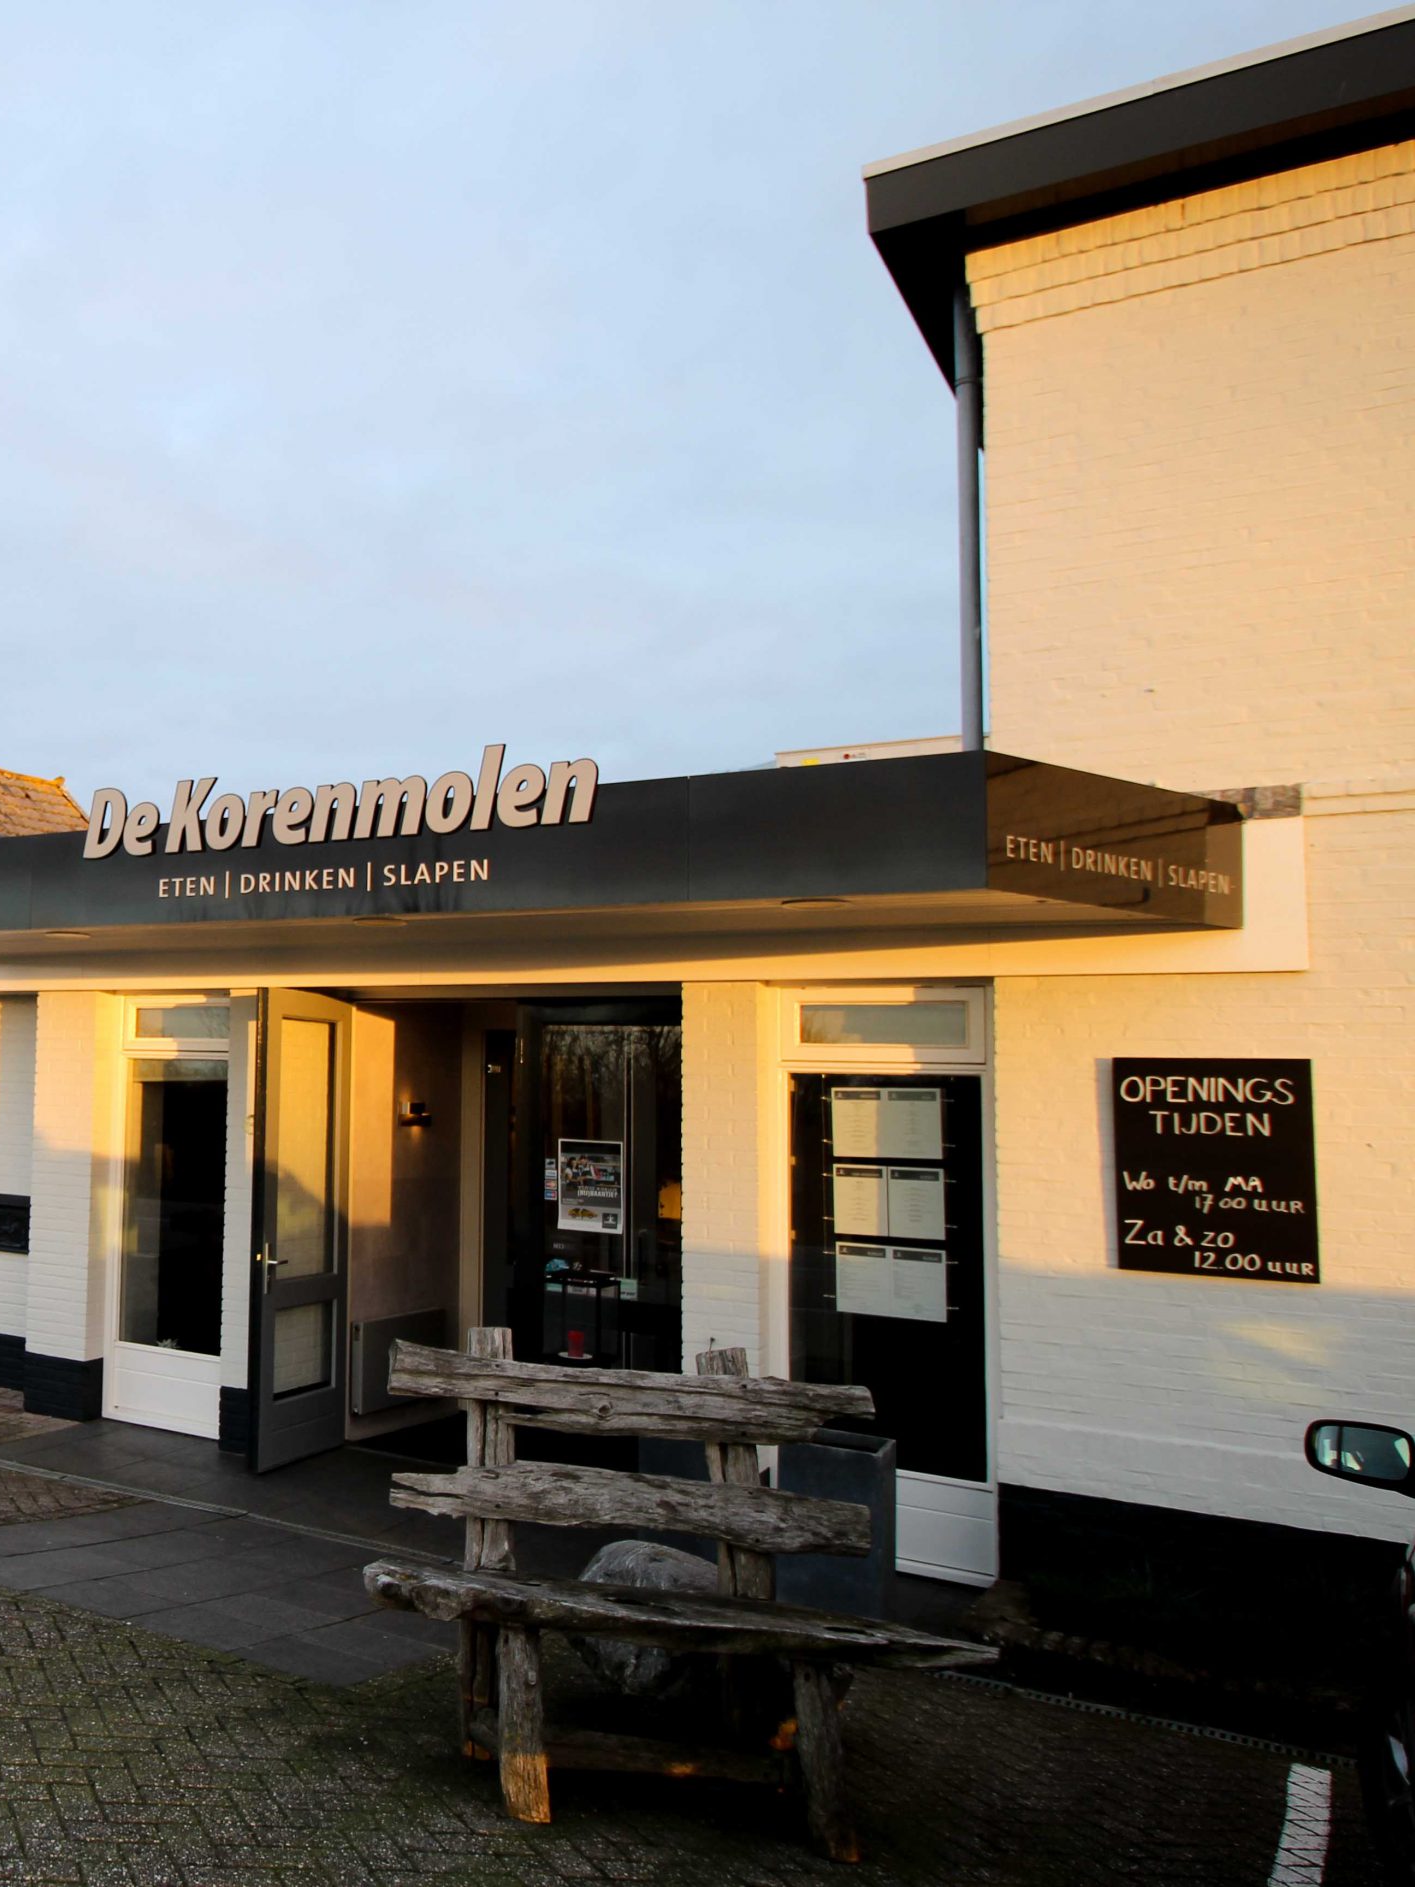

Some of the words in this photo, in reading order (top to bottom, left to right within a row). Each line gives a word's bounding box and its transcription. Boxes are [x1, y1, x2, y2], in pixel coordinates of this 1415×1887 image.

[83, 787, 160, 859] De
[165, 744, 598, 854] Korenmolen
[159, 876, 215, 898] ETEN
[240, 868, 355, 894] DRINKEN
[384, 859, 489, 887] SLAPEN
[1006, 835, 1054, 864] ETEN
[1072, 847, 1152, 881] DRINKEN
[1168, 865, 1230, 895] SLAPEN
[1120, 1076, 1295, 1105] OPENINGS
[1149, 1110, 1272, 1137] TIJDEN
[1123, 1171, 1155, 1191] Wo
[1168, 1175, 1208, 1194] t/m
[1224, 1176, 1263, 1193] MA
[1124, 1219, 1164, 1246] Za
[1173, 1225, 1194, 1247] &
